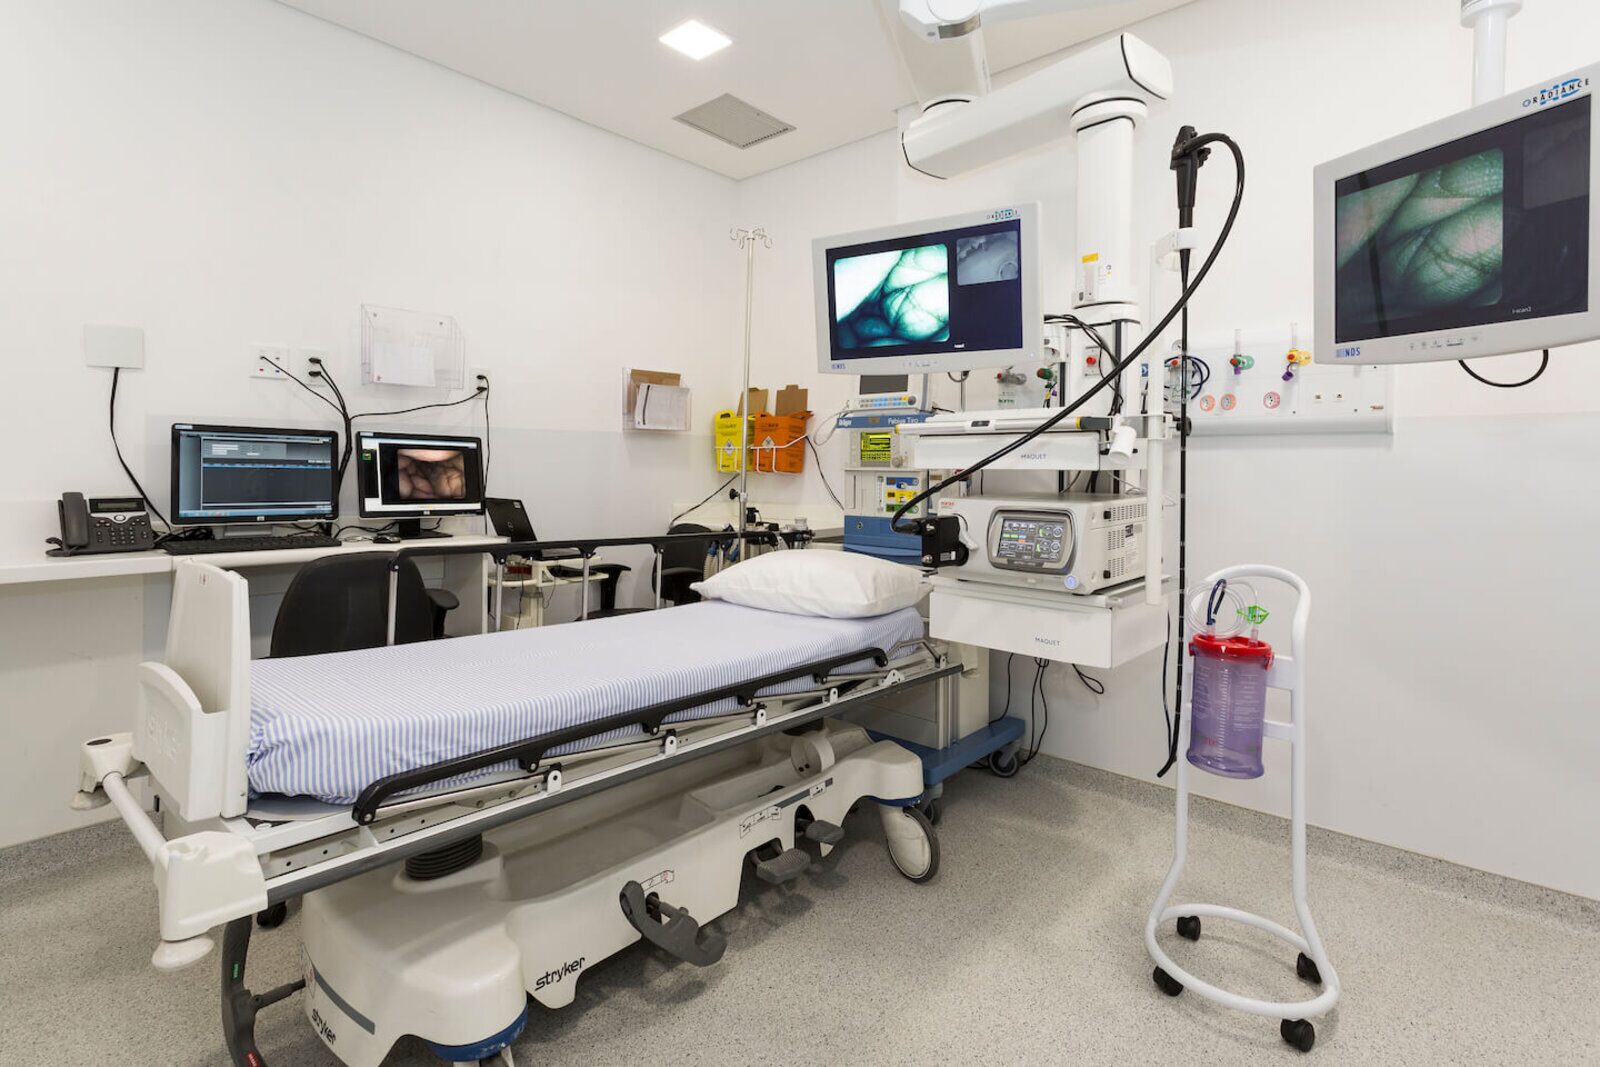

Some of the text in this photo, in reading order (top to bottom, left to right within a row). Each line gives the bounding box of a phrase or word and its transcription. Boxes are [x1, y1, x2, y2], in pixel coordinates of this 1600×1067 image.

[1532, 78, 1590, 104] RADIANCE
[1034, 636, 1061, 647] MAQUET
[534, 956, 586, 992] stryker
[311, 1008, 337, 1046] stryker
